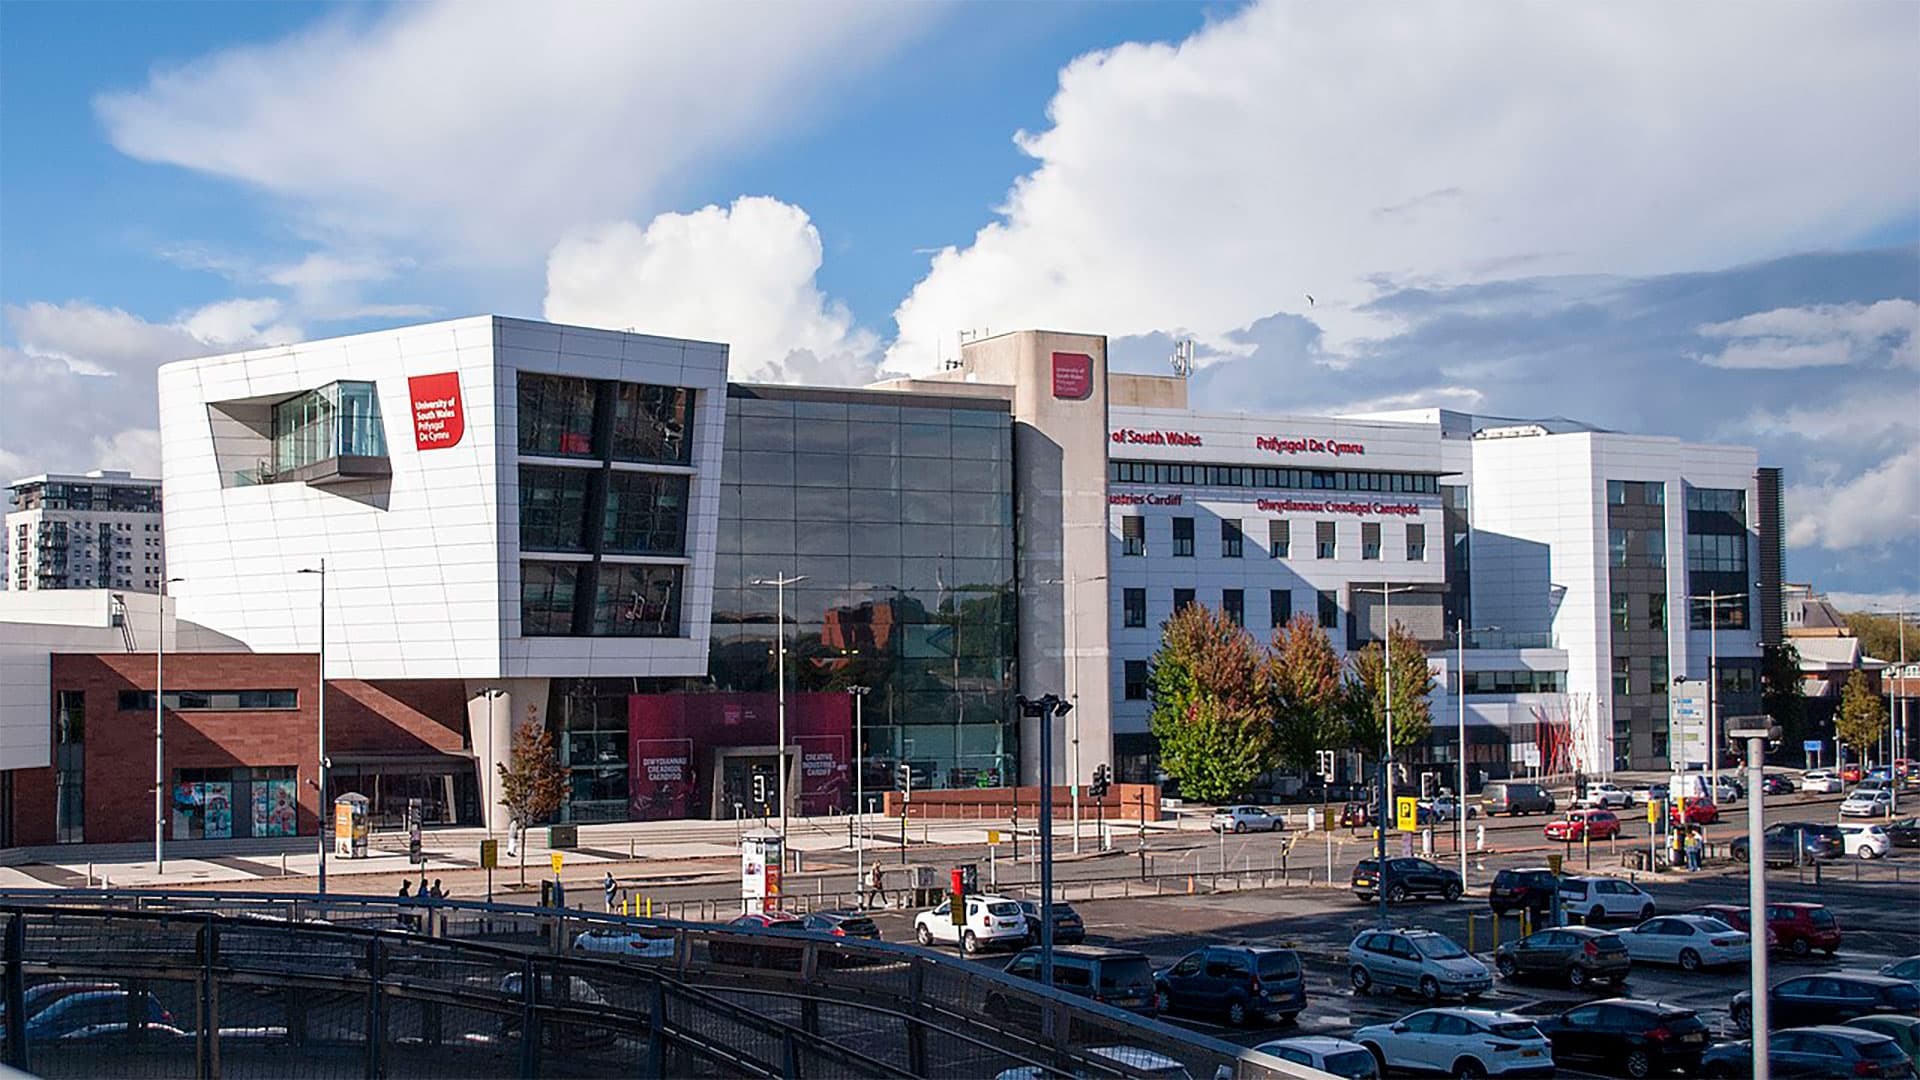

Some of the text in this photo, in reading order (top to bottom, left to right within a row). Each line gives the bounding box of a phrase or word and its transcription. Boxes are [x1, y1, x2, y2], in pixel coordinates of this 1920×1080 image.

[414, 397, 456, 410] University of
[416, 410, 455, 421] South Wales
[417, 420, 445, 432] Prifysgol
[419, 432, 450, 442] De Cymru
[1112, 429, 1202, 447] of South Wales
[1256, 436, 1365, 457] Prifysgol De Cymru
[1145, 492, 1183, 507] Cardiff
[1257, 498, 1420, 518] Diwydiannau Creadigol Caerdydd
[1402, 803, 1410, 817] P
